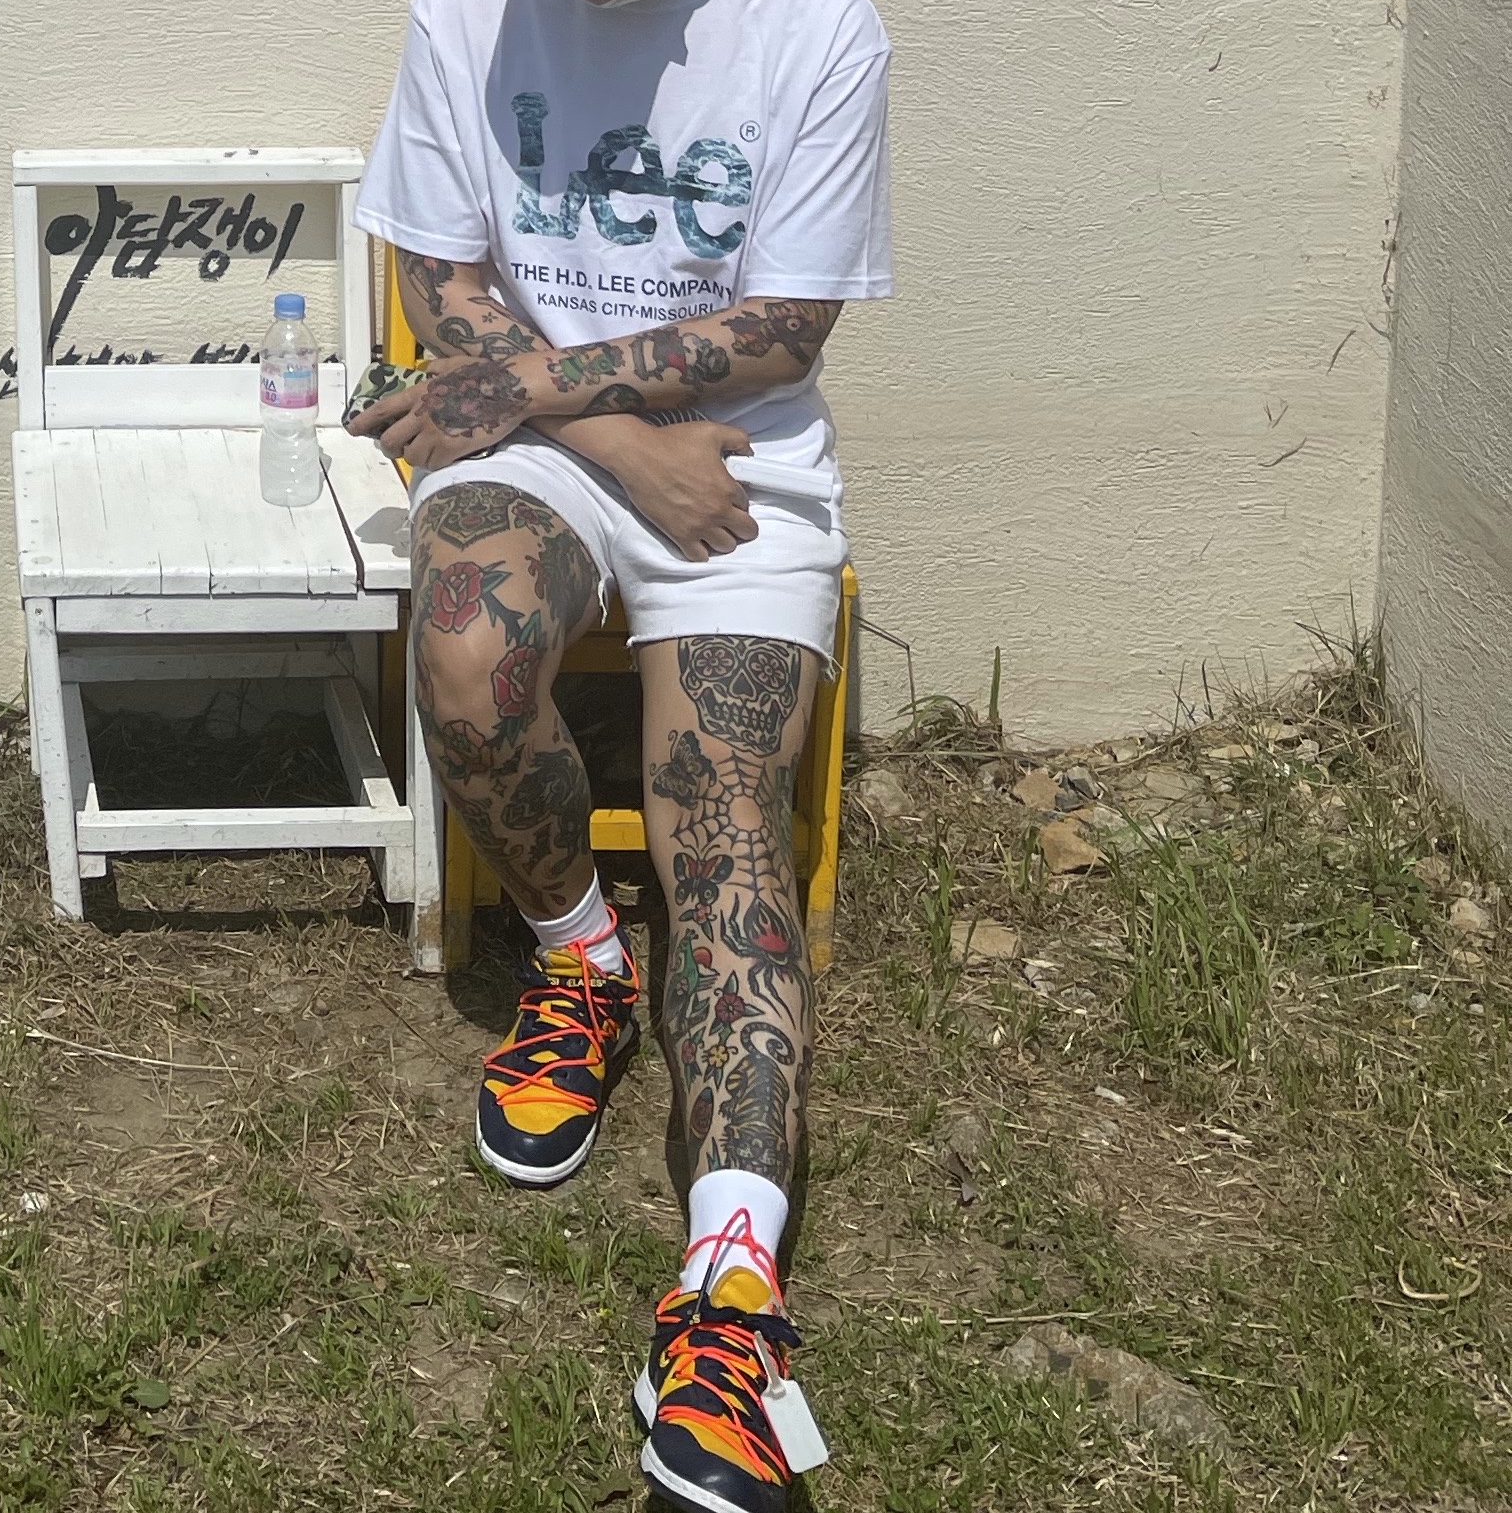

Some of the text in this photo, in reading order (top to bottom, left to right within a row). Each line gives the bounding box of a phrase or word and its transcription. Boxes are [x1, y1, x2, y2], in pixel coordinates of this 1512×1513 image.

[511, 91, 752, 259] Lee
[511, 262, 732, 302] THE H.D. LEE COMPANY
[537, 292, 597, 314] KANSAS
